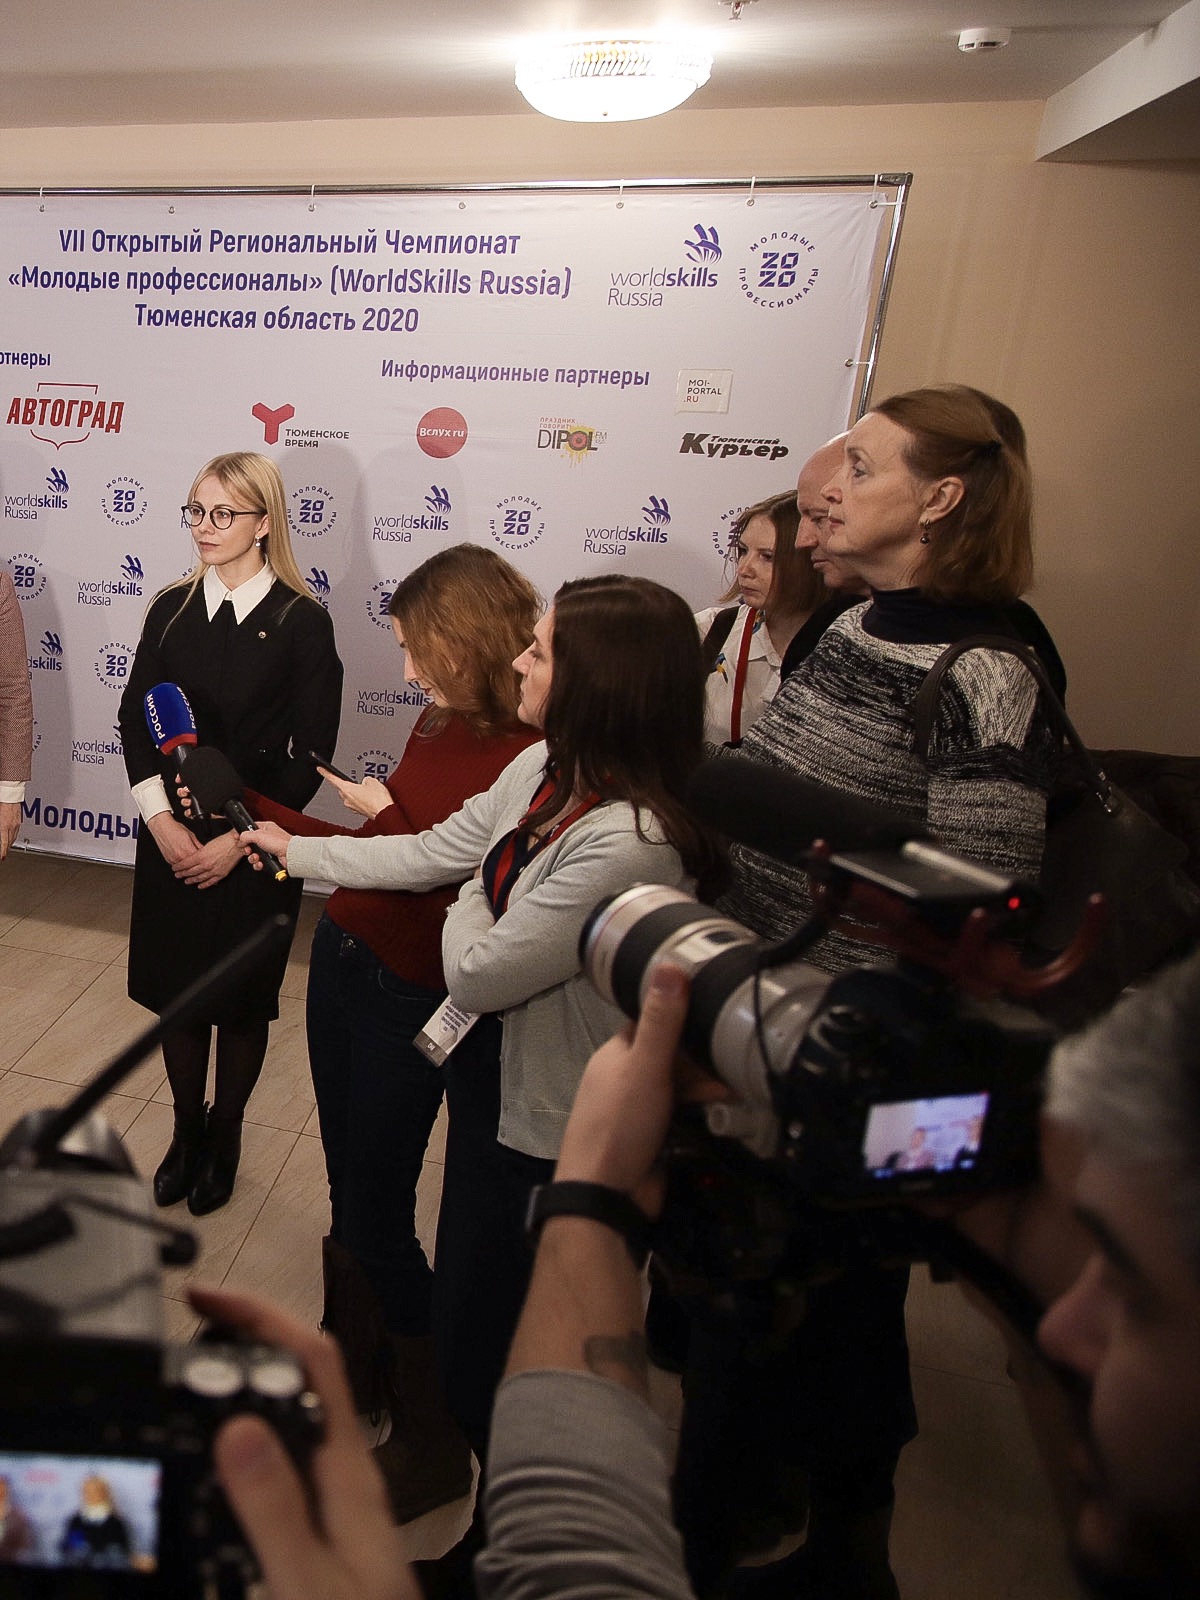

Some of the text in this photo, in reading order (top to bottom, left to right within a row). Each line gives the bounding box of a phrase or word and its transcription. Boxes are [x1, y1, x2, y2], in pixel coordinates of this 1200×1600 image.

[59, 228, 521, 258] VII Открытый Региональный Чемпионат
[749, 231, 816, 254] МОЛОДЫЕ
[8, 265, 572, 299] «Молодые профессионалы» (WorldSkills Russia)
[610, 267, 719, 288] worldskills
[608, 287, 664, 307] Russia
[738, 267, 819, 309] ПРОФЕССИОНАЛЫ
[134, 303, 419, 332] Тюменская область 2020
[381, 359, 650, 389] Информационные партнеры
[6, 397, 125, 434] АВТОГРАД
[285, 429, 350, 439] ТЮМЕНСКОЕ
[537, 429, 598, 451] DIPOL
[711, 435, 780, 445] Тюменский
[285, 439, 319, 448] ВРЕМЯ
[679, 432, 789, 460] Курьер
[5, 494, 68, 509] worldskills
[4, 505, 38, 520] Russia
[374, 514, 449, 531] worldskills
[373, 528, 412, 542] Russia
[585, 525, 668, 544] worldskills
[583, 539, 626, 556] Russia
[78, 580, 143, 597] worldskills
[372, 579, 397, 591] МОЛО
[77, 592, 111, 606] Russia
[27, 655, 62, 671] dskills
[94, 662, 127, 689] ПРОФЕССИО
[358, 689, 431, 707] worldskills
[147, 693, 166, 740] РОССИЯ
[357, 701, 395, 717] Russia
[72, 740, 122, 755] worldski
[71, 750, 104, 765] Russia
[22, 797, 138, 840] Молоды
